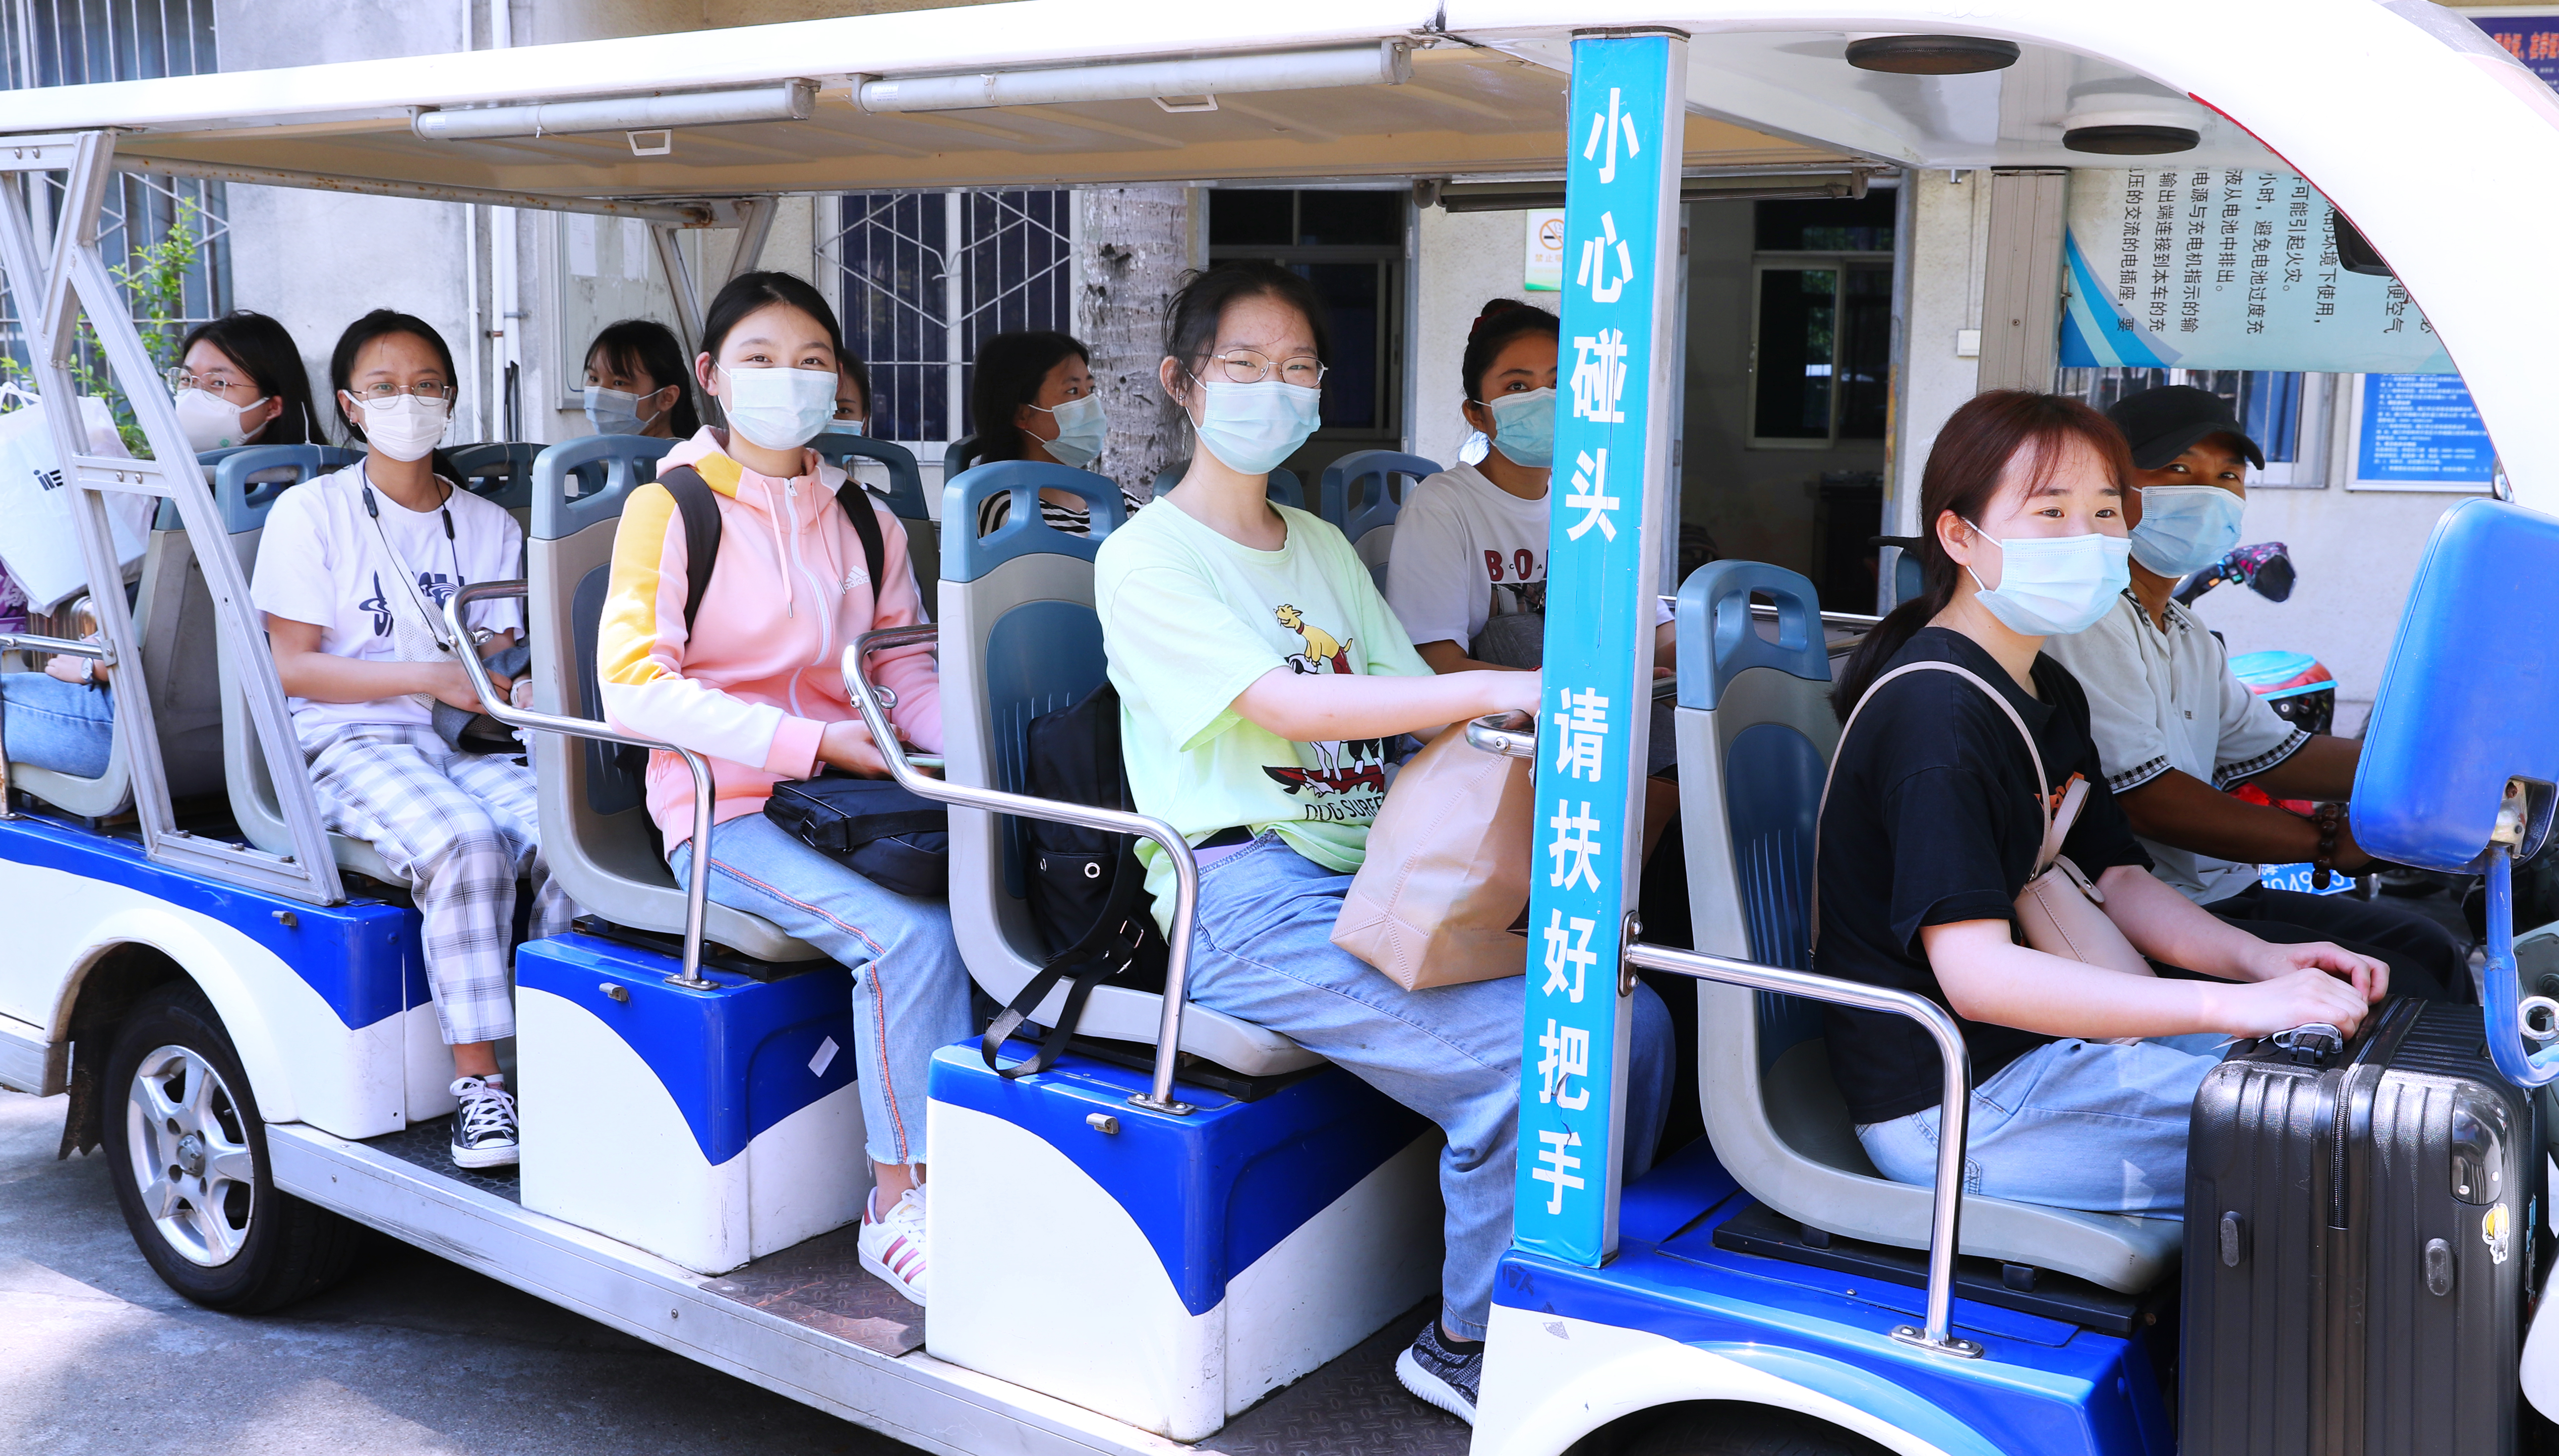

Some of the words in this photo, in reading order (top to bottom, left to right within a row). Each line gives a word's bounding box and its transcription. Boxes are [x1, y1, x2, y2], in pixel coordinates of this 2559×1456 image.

[1566, 87, 1640, 542] 小心碰头
[2116, 169, 2145, 334] 压的交流的电插座，要
[1532, 687, 1609, 1215] 请扶好把手
